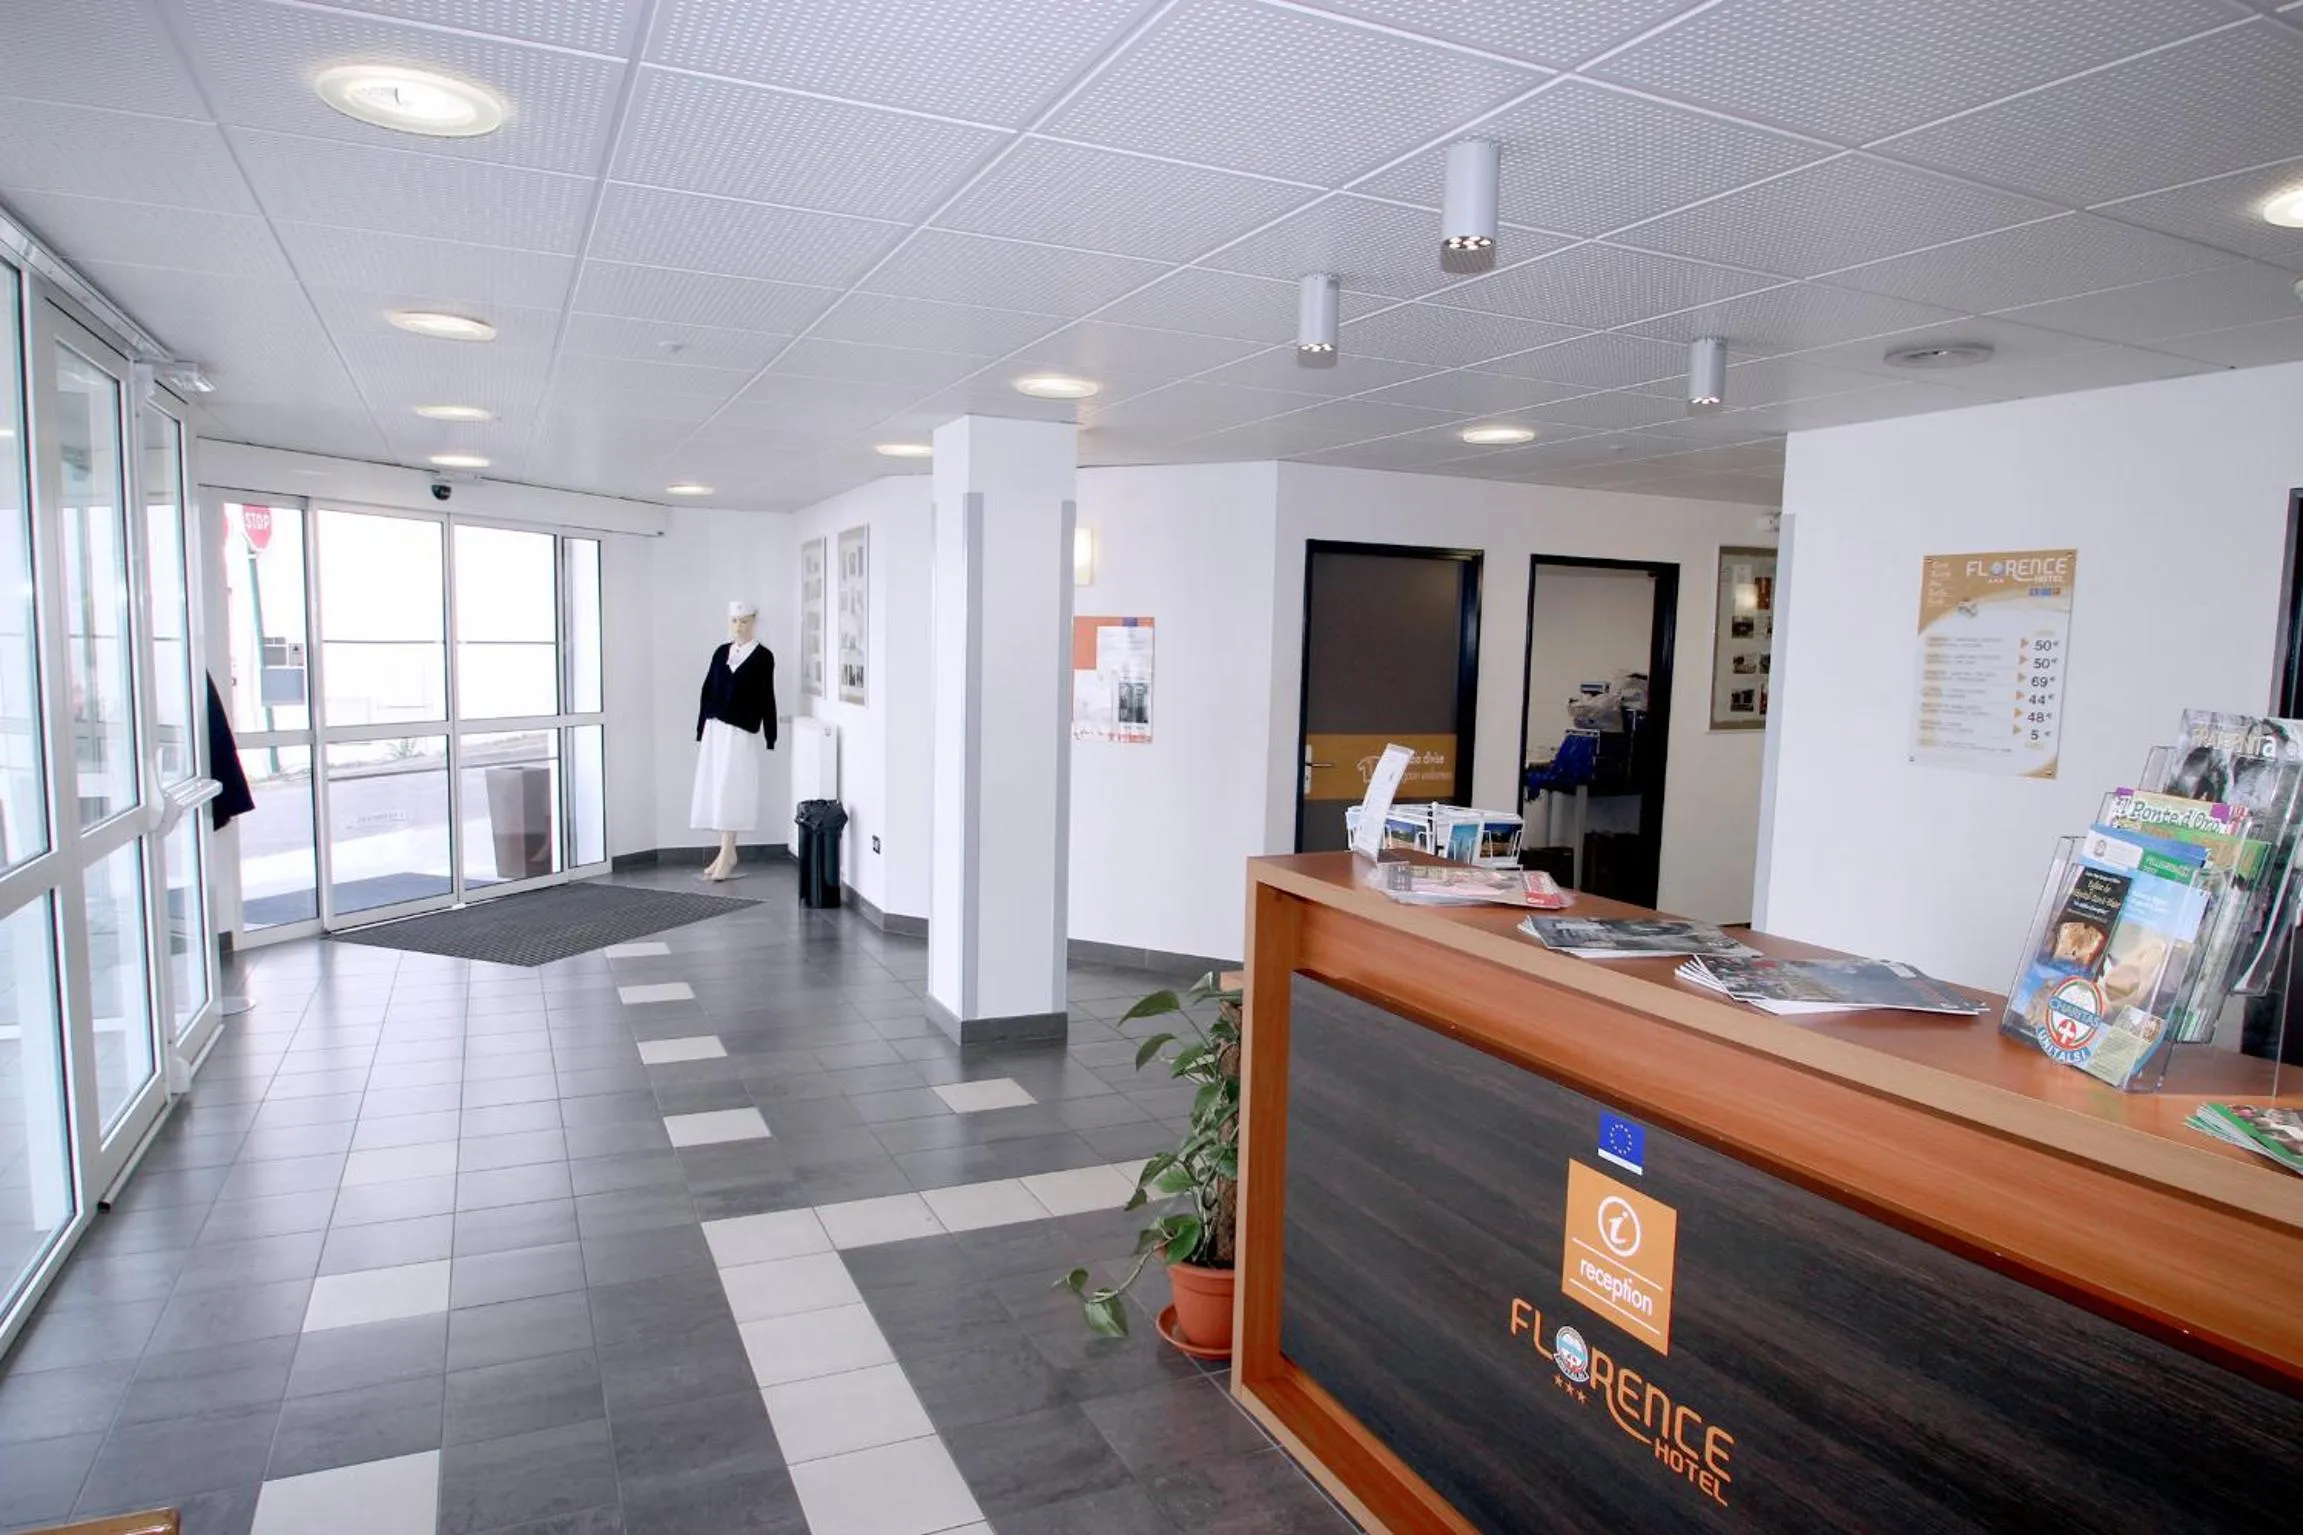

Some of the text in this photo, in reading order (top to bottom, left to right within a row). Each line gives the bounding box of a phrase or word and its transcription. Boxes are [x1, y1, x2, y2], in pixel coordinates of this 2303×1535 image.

[245, 511, 270, 529] STOP
[2132, 801, 2178, 823] Ponte
[1580, 1258, 1653, 1317] reception
[1654, 1437, 1729, 1507] HOTEL
